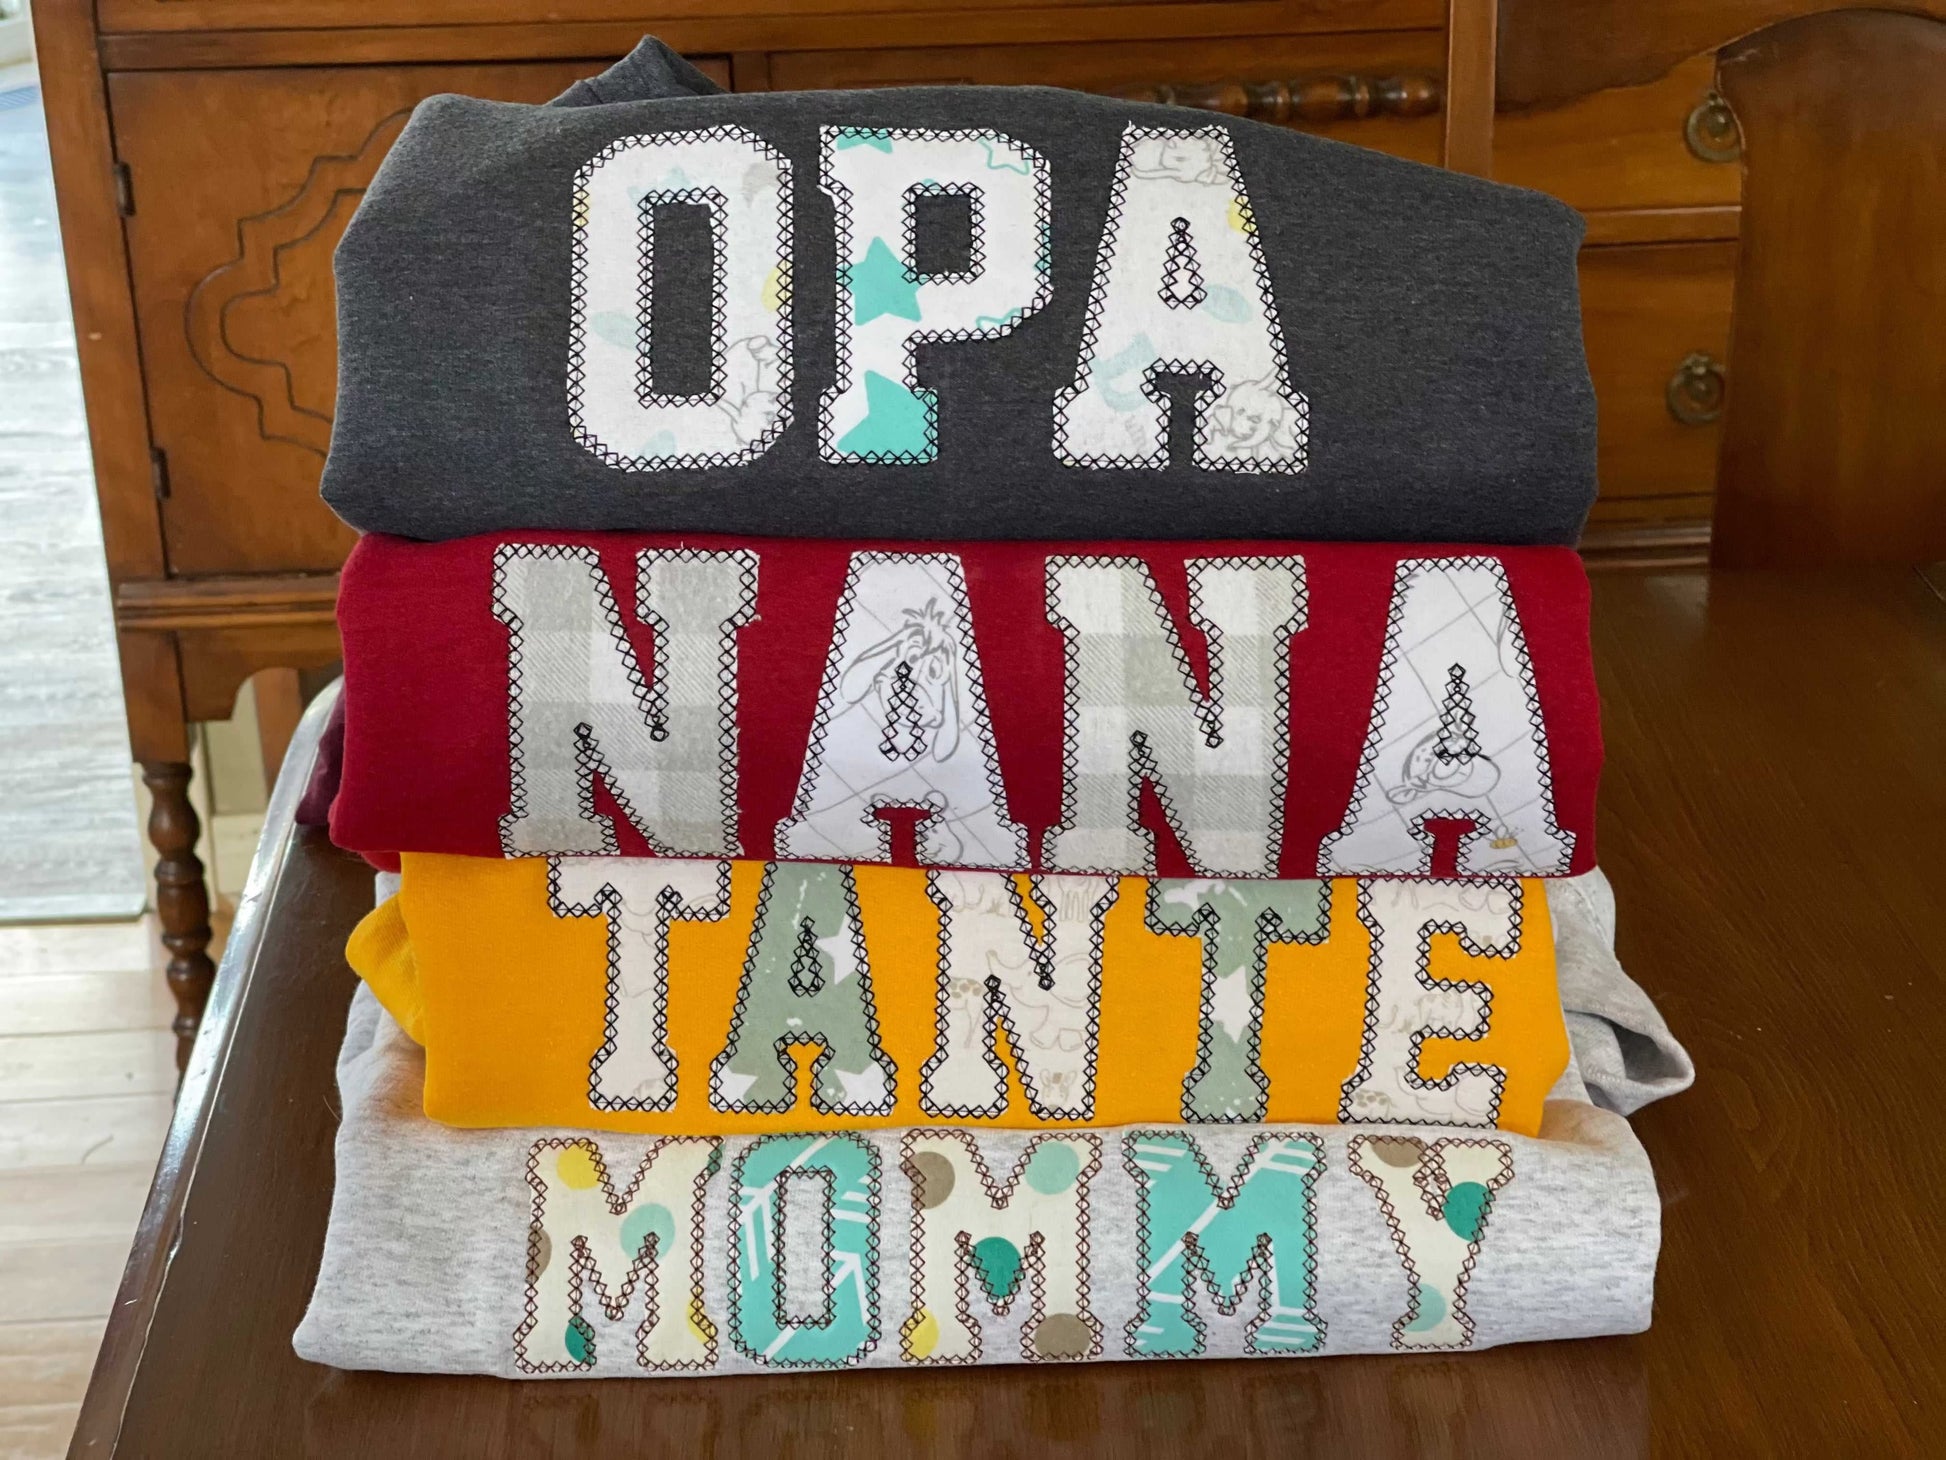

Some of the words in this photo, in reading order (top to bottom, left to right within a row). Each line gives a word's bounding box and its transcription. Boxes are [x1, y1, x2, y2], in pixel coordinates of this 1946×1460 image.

[567, 123, 1310, 475] OPA
[492, 542, 1578, 878] NANA
[547, 856, 1524, 1126] TANTE
[514, 1131, 1515, 1377] MOMMY
